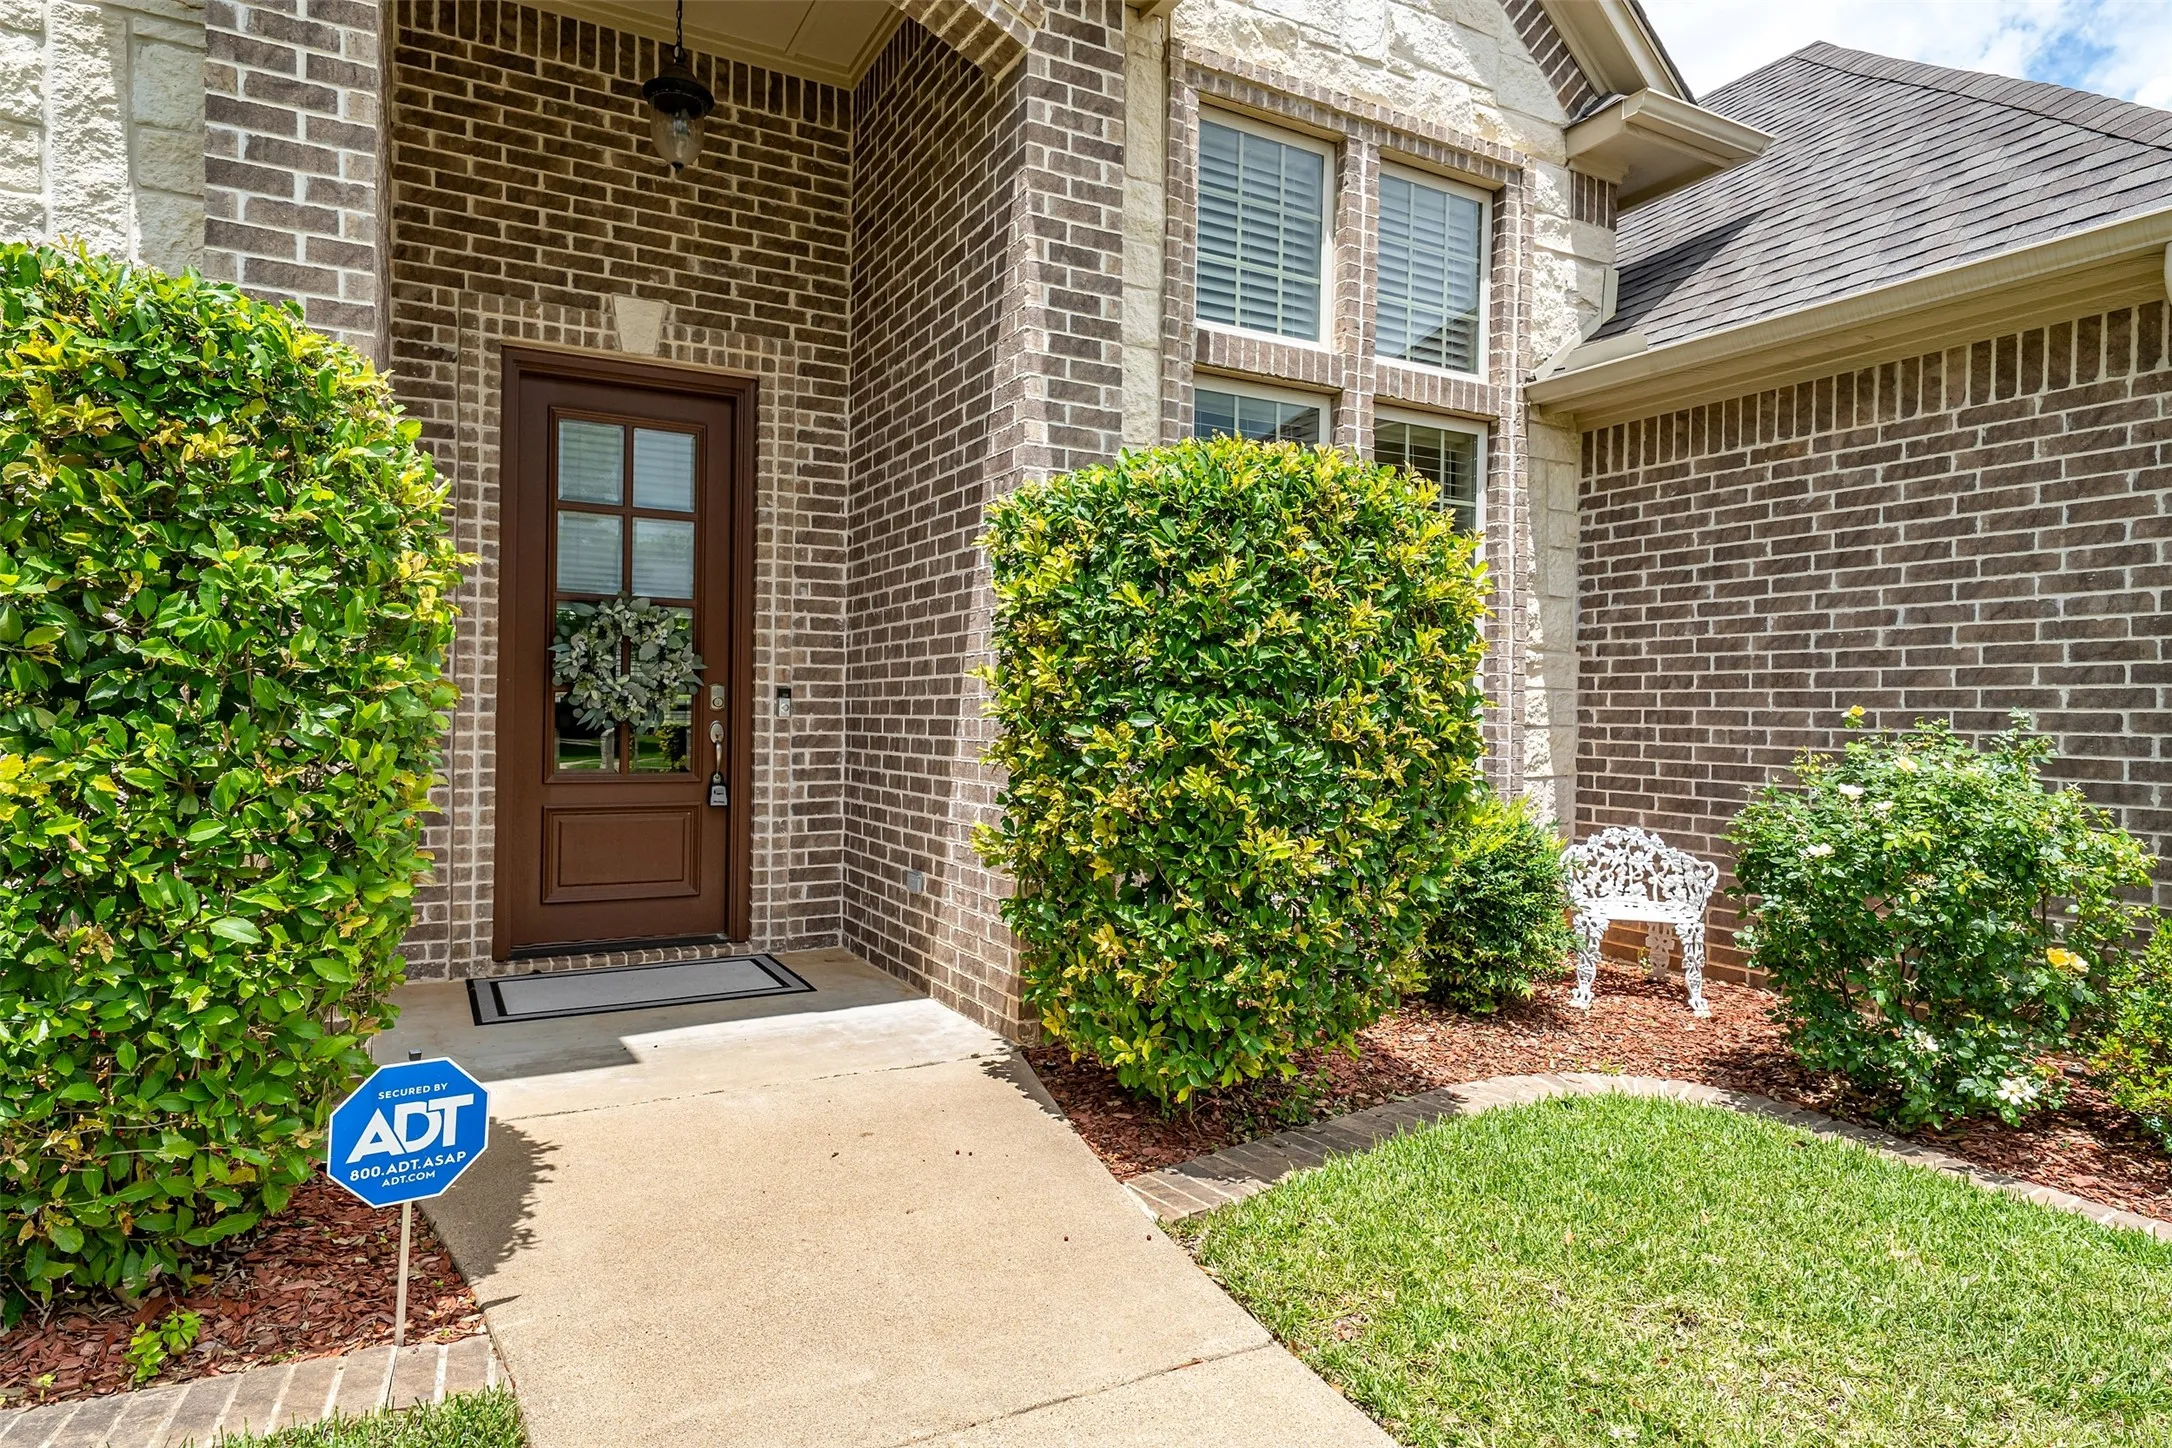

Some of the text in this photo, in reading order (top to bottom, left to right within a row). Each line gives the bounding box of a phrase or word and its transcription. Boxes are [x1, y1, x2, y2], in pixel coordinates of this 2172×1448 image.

[378, 1082, 448, 1100] SECURED BY
[345, 1093, 474, 1165] ADT
[350, 1151, 467, 1181] 800.ADT.ASAP
[381, 1170, 436, 1187] ADT.COM
